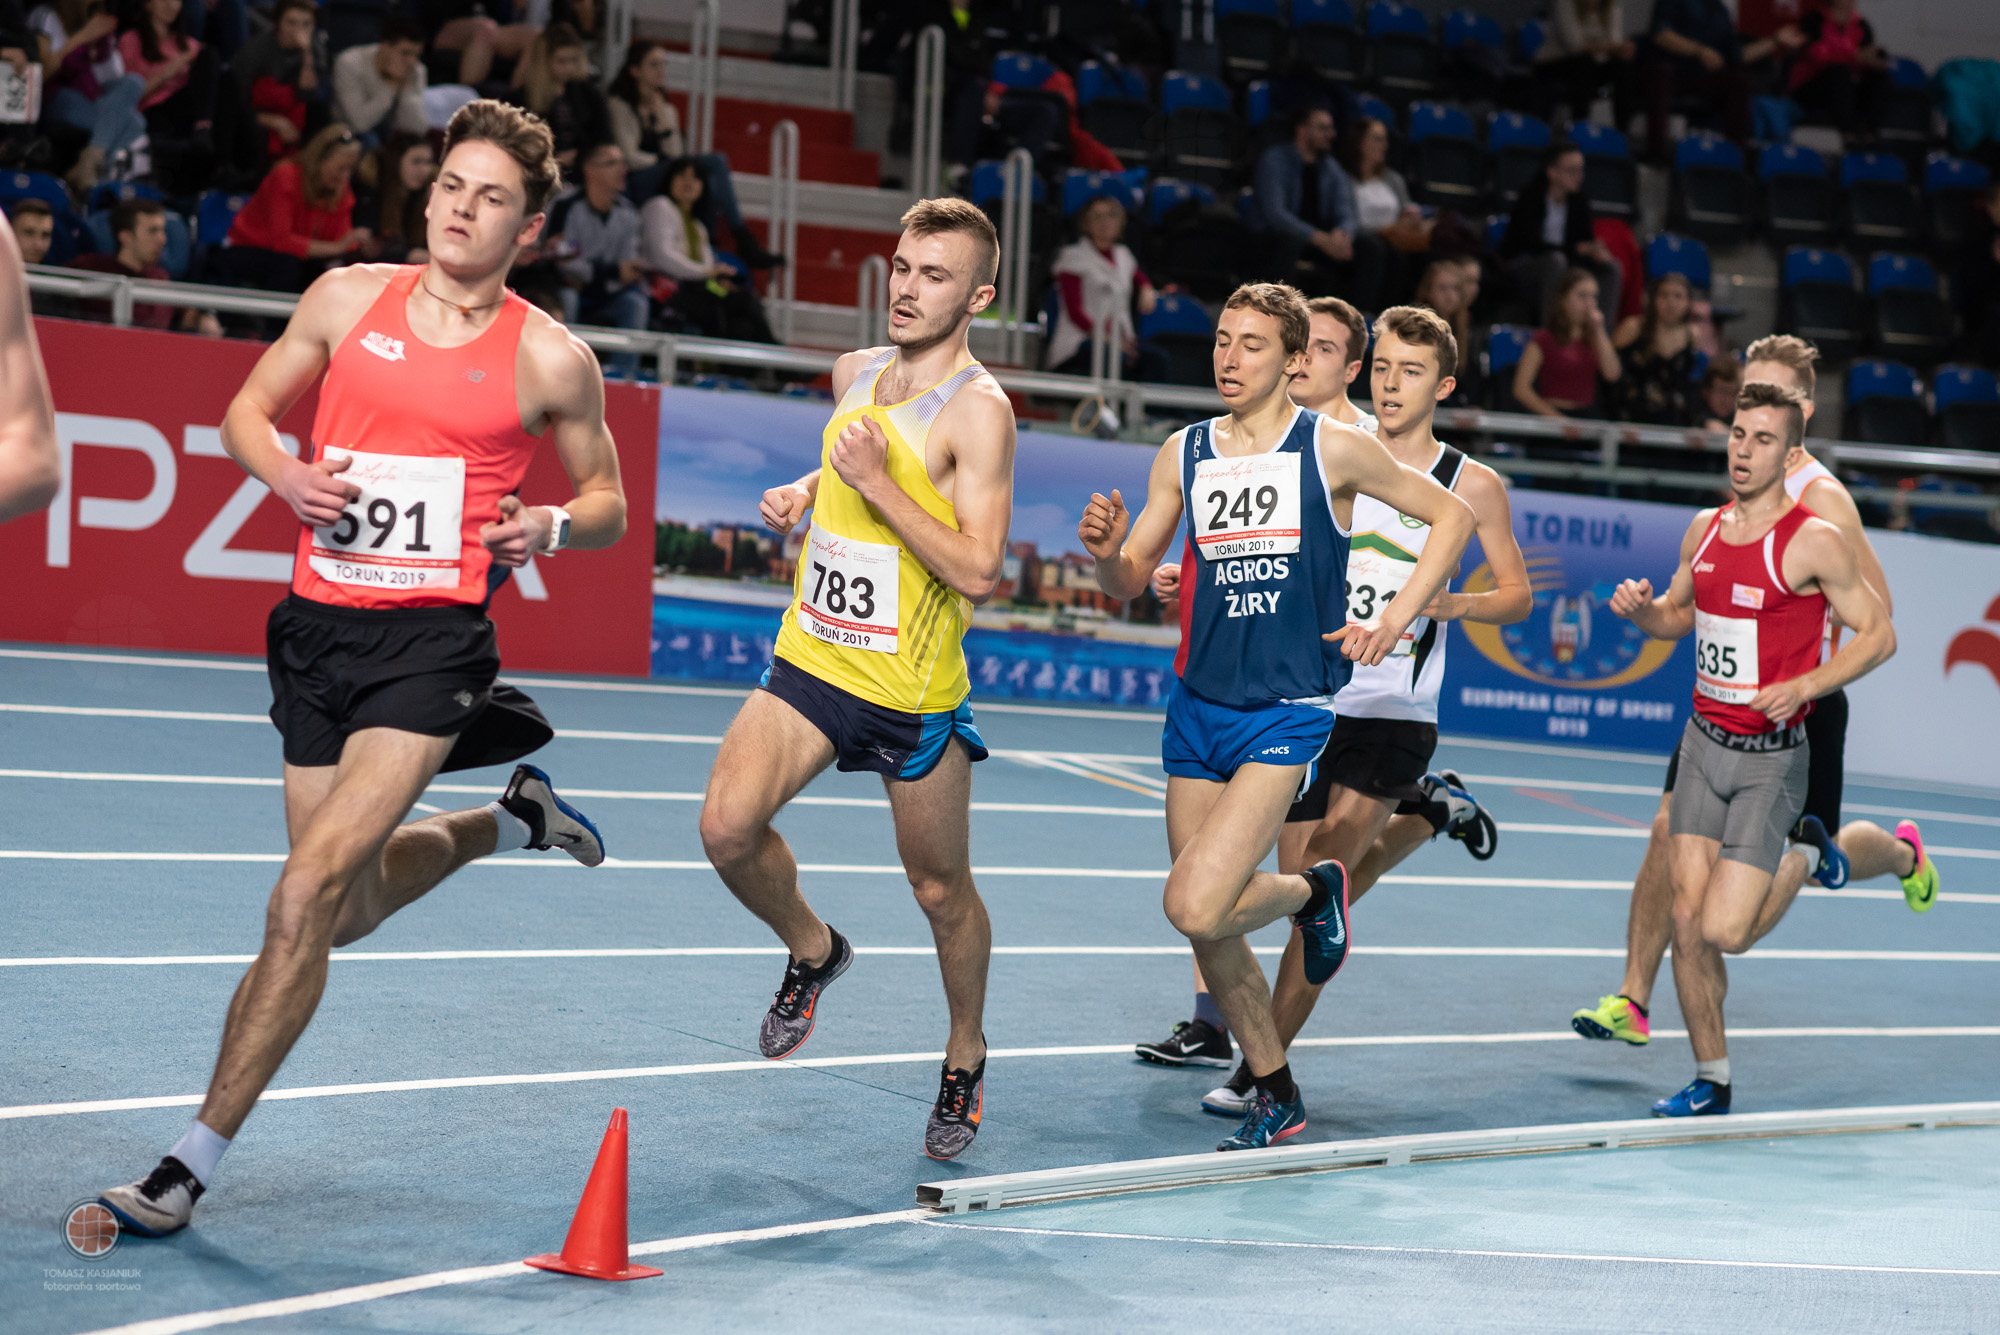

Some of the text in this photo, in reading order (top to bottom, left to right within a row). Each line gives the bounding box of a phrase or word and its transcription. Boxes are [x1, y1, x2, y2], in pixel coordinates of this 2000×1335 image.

[1207, 484, 1279, 531] 249
[331, 497, 431, 552] 591
[1524, 511, 1632, 549] TORUŃ
[1214, 540, 1275, 556] TORUŃ 2019
[335, 565, 426, 585] TORUŃ 2019
[1214, 556, 1290, 586] AGROS
[812, 560, 875, 619] 783
[1225, 588, 1281, 618] ŻARY
[811, 620, 871, 646] TORUŃ 2019
[1697, 638, 1738, 679] 635
[1460, 686, 1675, 721] EUROPEAN CITY OF SPORT
[1718, 689, 1737, 701] 2019
[1727, 731, 1784, 751] PRO
